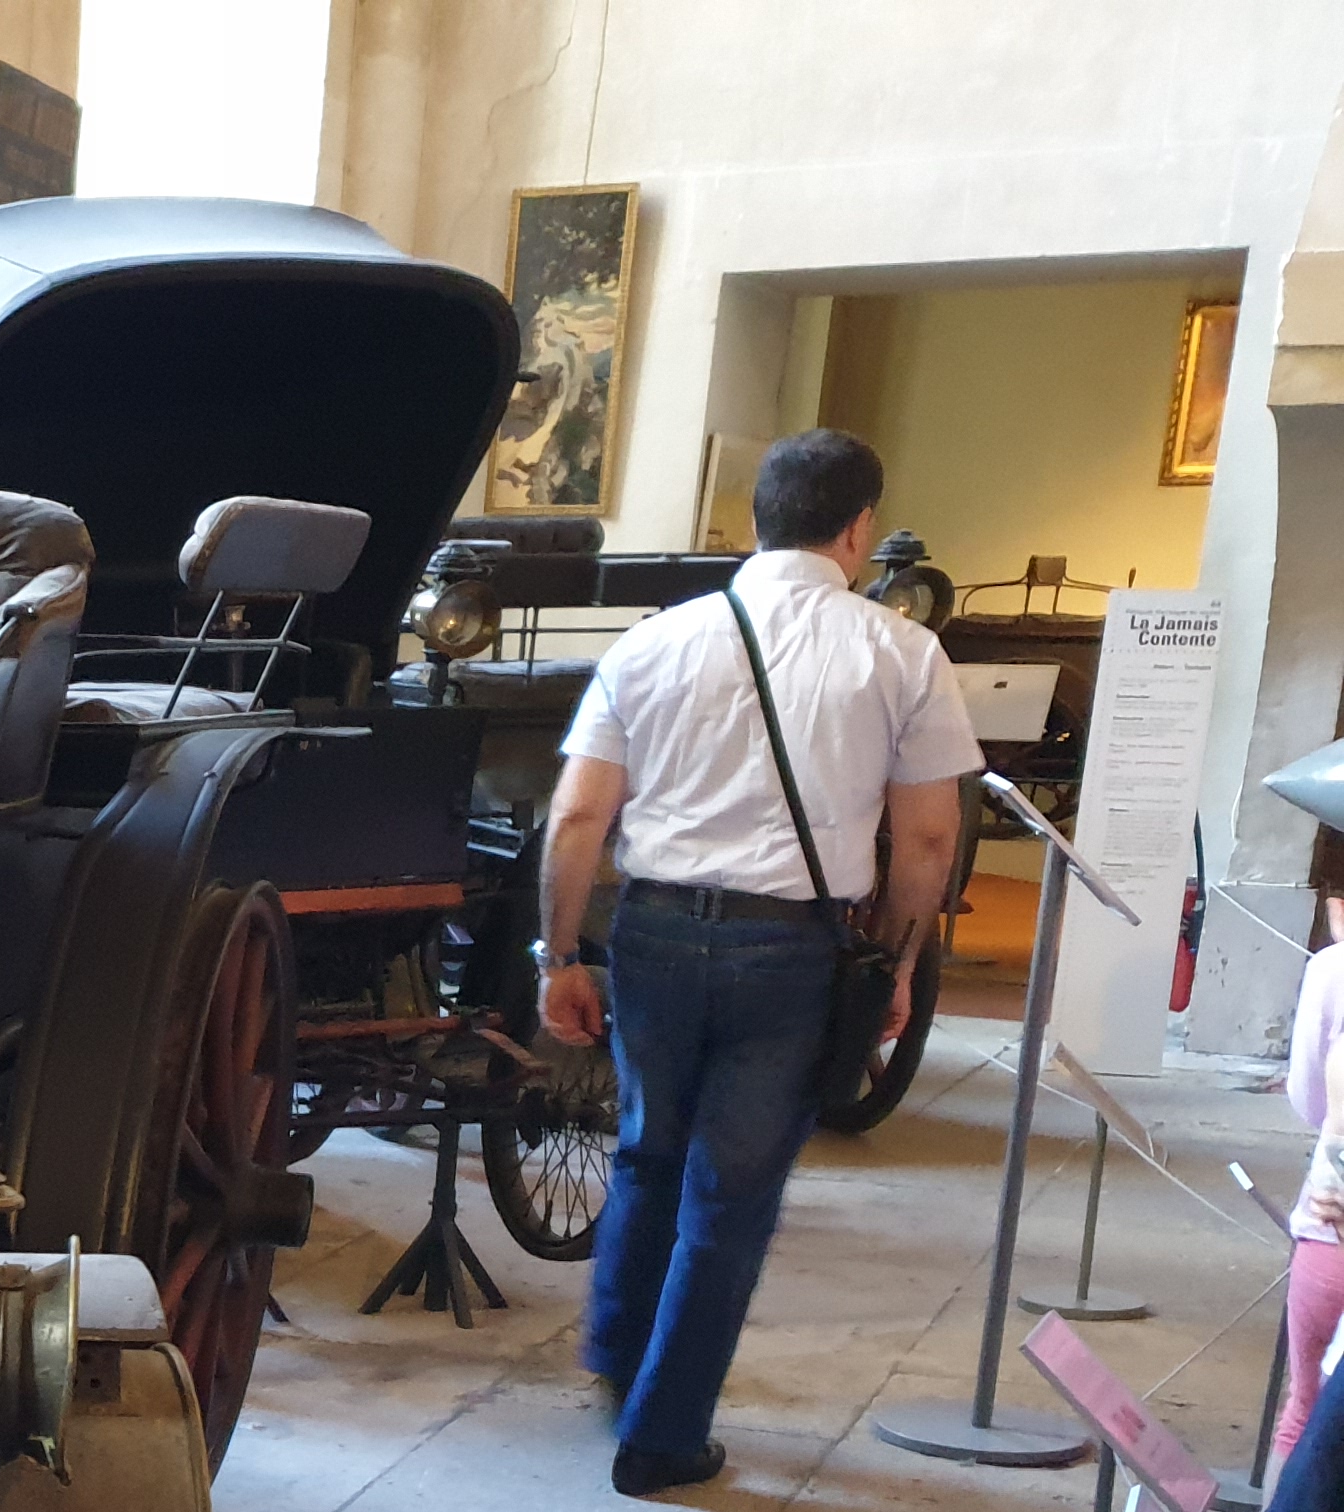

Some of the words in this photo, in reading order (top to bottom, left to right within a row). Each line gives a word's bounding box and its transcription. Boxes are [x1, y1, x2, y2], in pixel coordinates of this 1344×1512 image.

[1130, 615, 1149, 630] La
[1154, 615, 1218, 631] Jamais
[1138, 630, 1217, 647] Contente
